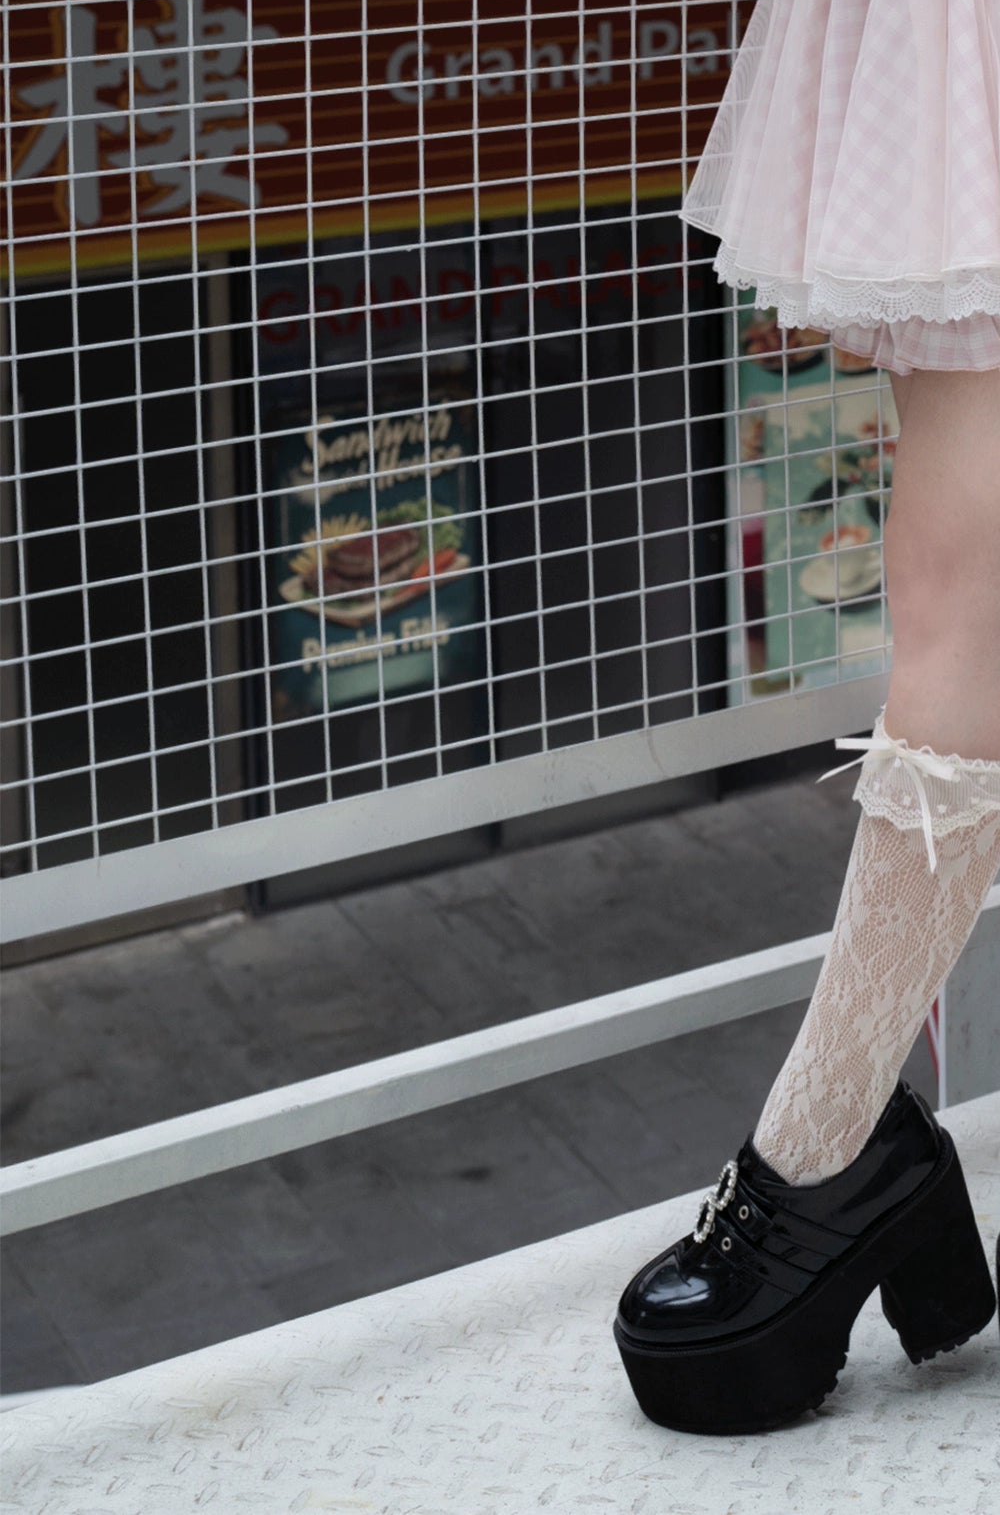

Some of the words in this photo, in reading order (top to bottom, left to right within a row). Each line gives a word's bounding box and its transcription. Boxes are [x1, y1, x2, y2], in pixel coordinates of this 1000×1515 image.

[386, 20, 613, 105] Grand
[259, 268, 474, 343] GRAND
[489, 240, 706, 316] PALACE
[301, 399, 453, 473] Sandwich
